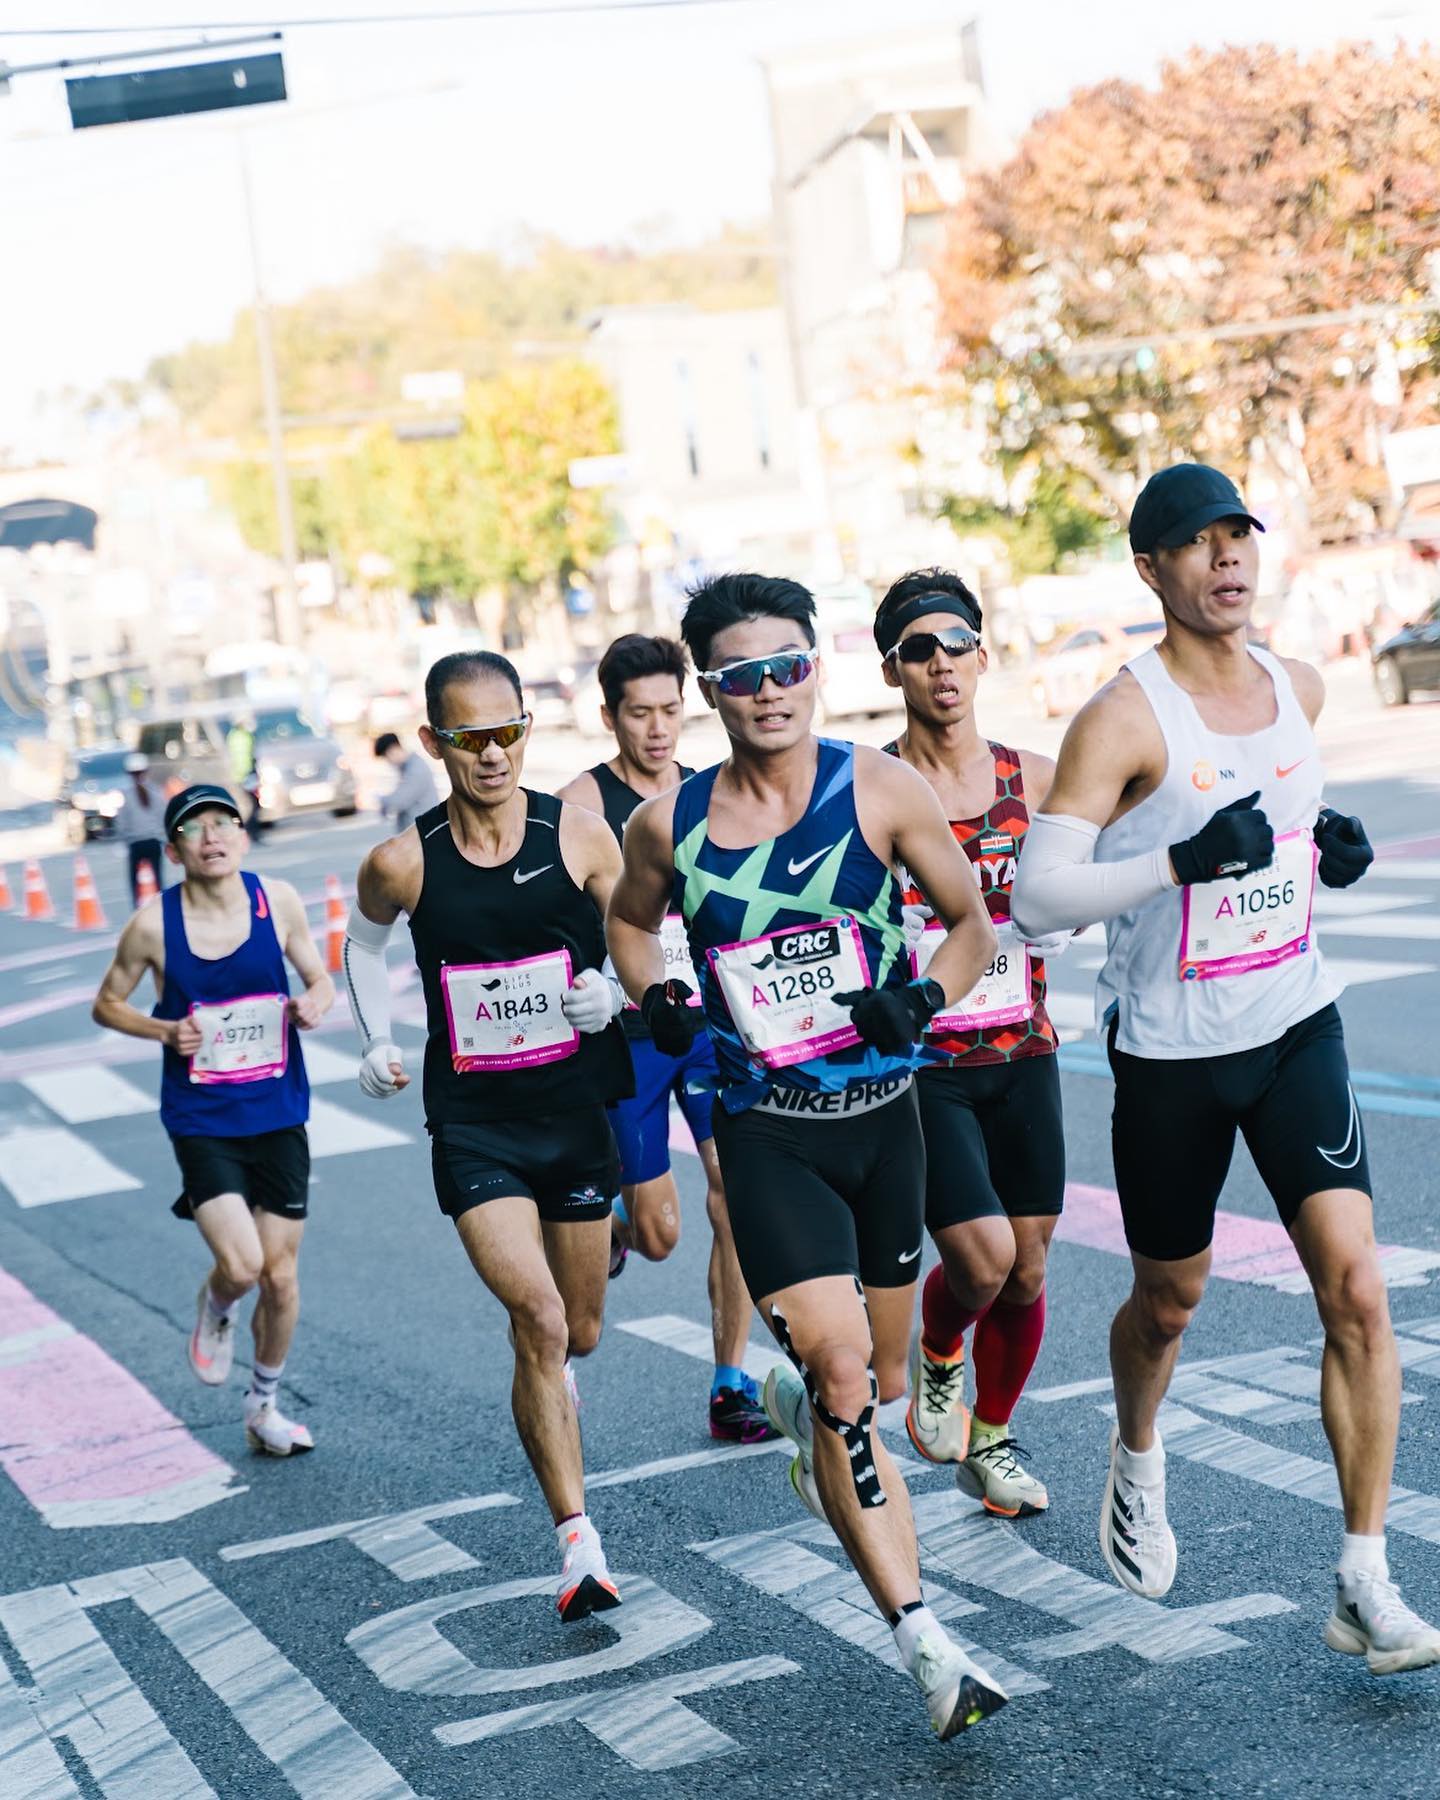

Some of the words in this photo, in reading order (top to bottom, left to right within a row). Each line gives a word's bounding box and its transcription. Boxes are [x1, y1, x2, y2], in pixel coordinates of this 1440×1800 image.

[901, 857, 1018, 892] KYA
[1214, 880, 1295, 920] A1056
[781, 930, 830, 958] CRC
[504, 973, 531, 983] LIFE
[505, 980, 532, 991] PLUS
[751, 965, 835, 1009] A1288
[475, 993, 549, 1021] A1843
[213, 1024, 264, 1044] A9721
[762, 1086, 839, 1113] NIKE
